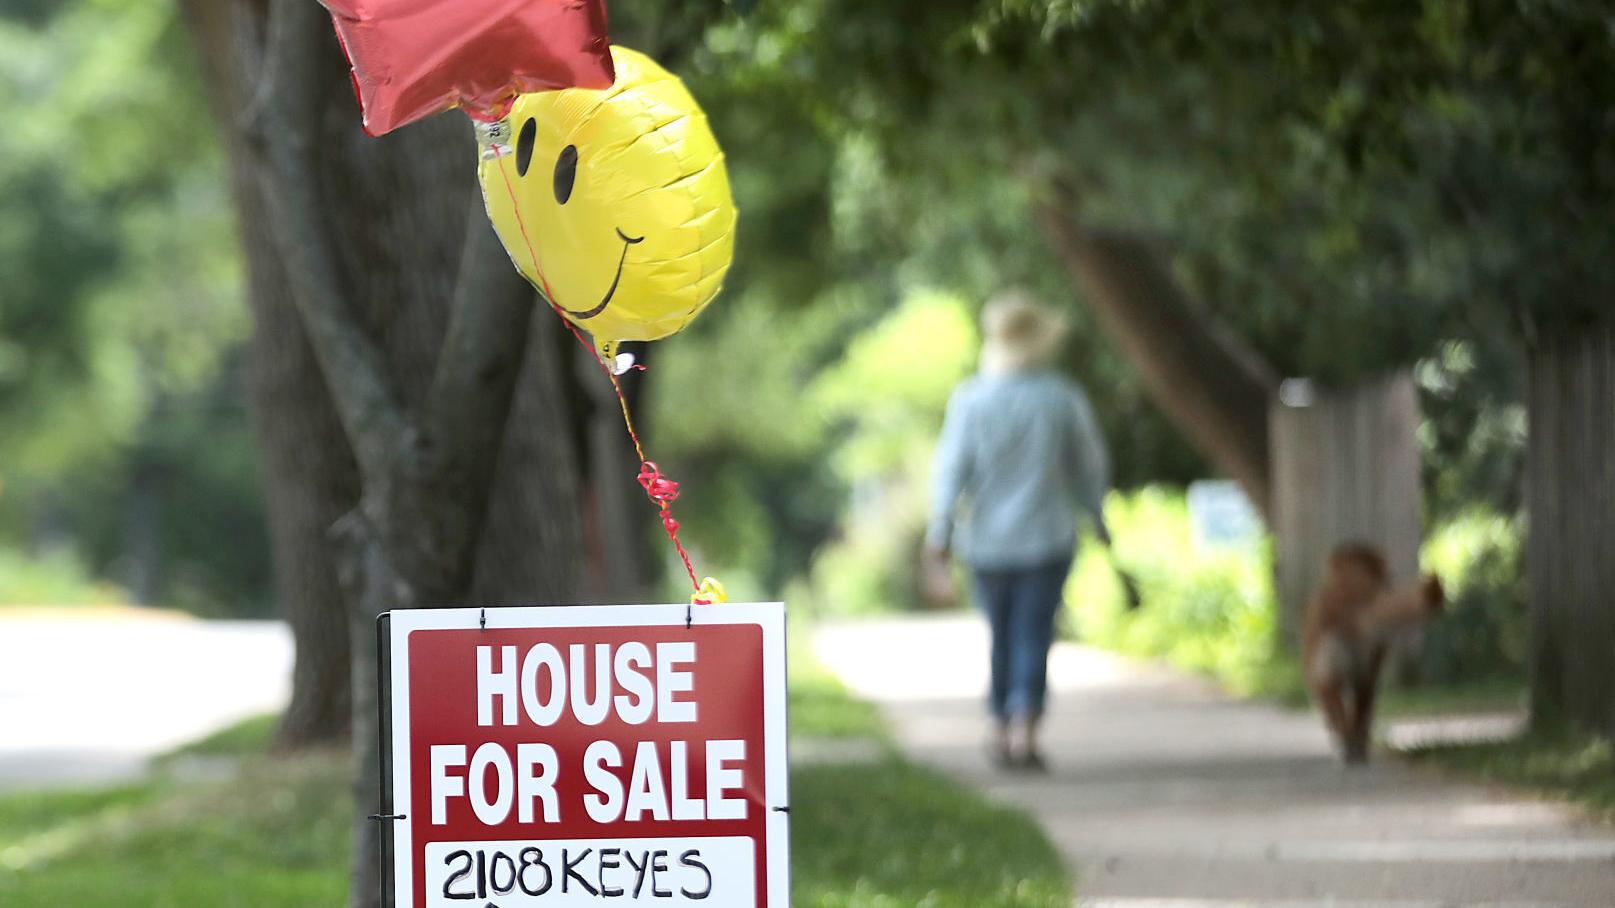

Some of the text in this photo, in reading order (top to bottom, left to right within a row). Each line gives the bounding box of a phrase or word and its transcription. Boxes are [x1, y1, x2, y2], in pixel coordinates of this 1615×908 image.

[476, 641, 697, 726] HOUSE
[430, 739, 747, 826] FOR SALE
[443, 846, 712, 900] 2108 KEYES
